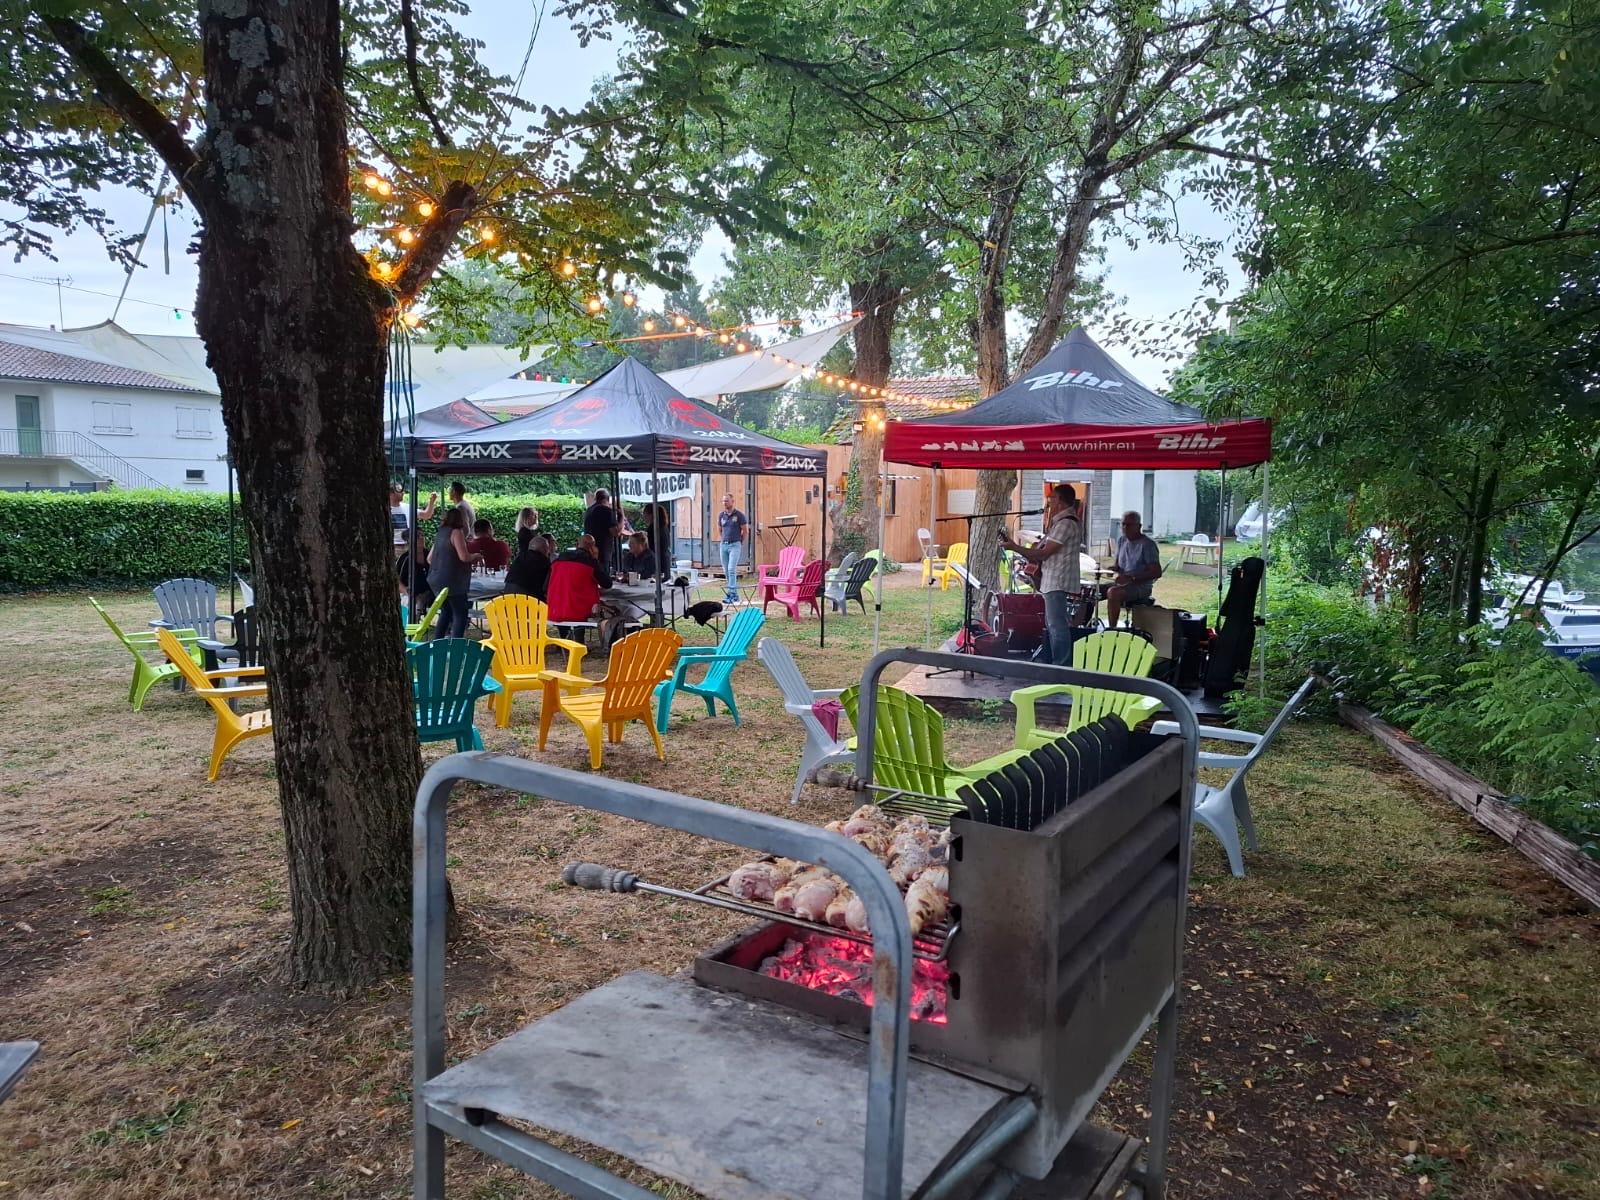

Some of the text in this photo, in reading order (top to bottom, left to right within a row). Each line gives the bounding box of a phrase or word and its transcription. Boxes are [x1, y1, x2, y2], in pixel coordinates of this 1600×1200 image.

[1023, 369, 1124, 391] Bihr
[1153, 433, 1227, 450] Bihr
[448, 443, 513, 459] 24MX
[561, 444, 635, 460] 24MX
[689, 446, 743, 464] 24MX
[775, 455, 818, 472] 24MX
